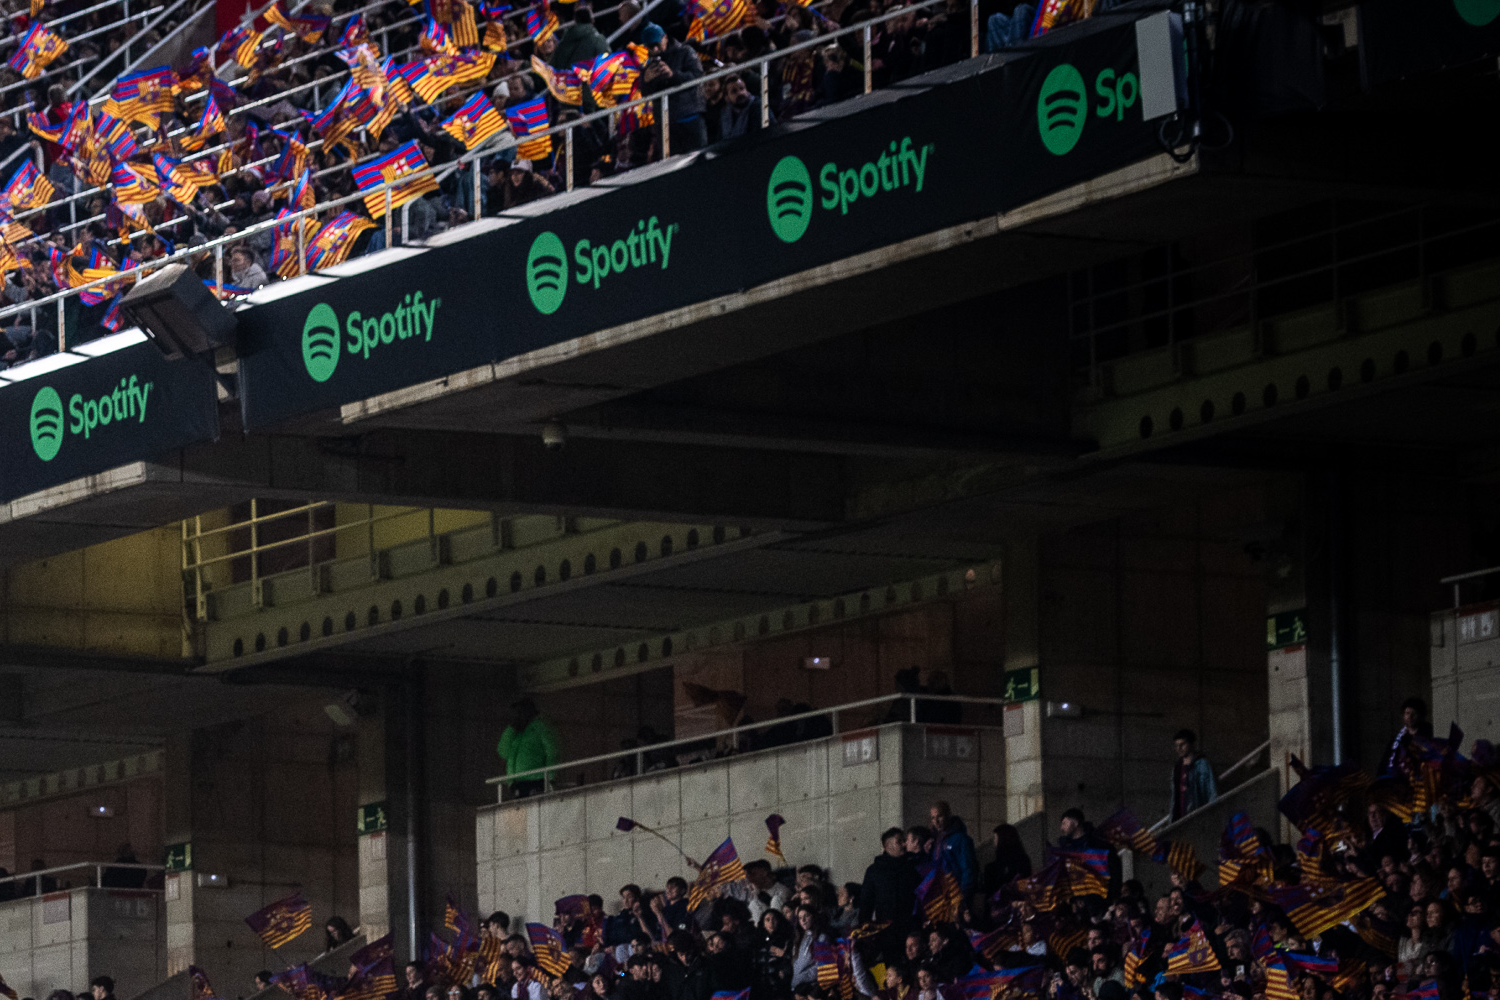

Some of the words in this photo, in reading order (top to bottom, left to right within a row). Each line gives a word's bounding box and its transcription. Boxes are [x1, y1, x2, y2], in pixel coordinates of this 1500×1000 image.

[819, 136, 934, 215] Spotify
[574, 215, 679, 290] Spotify
[346, 290, 441, 360] Spotify
[68, 374, 154, 440] Spotify
